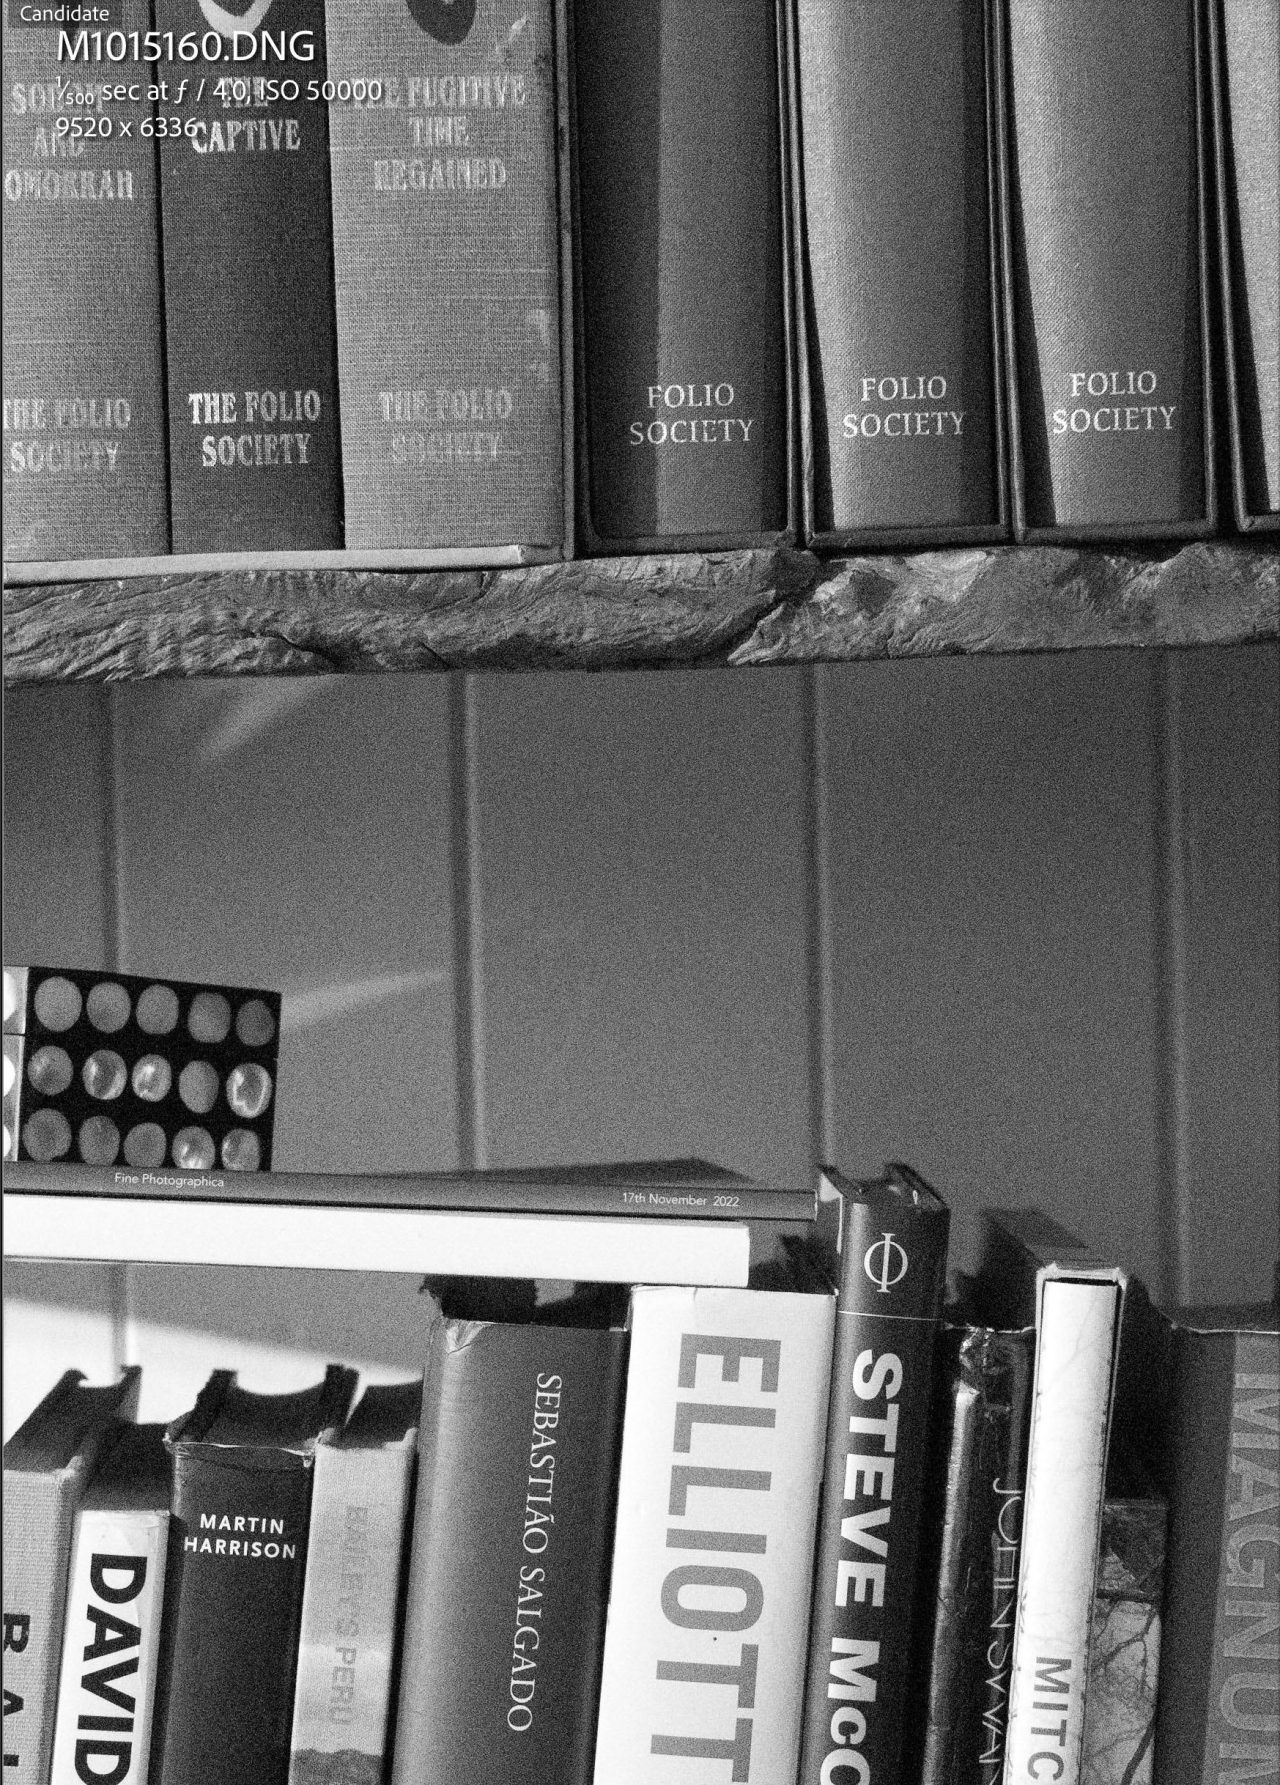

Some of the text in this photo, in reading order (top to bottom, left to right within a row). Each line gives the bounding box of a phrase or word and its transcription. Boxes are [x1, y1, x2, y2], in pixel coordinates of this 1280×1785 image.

[407, 74, 526, 108] FUGITIVE
[191, 119, 301, 153] CAPTIVE
[409, 115, 470, 148] TIME
[374, 158, 507, 191] REGAINED
[646, 383, 735, 408] FOLIO
[860, 376, 947, 401] FOLIO
[1069, 370, 1158, 397] FOLIO
[188, 390, 321, 425] THE FOLIO
[434, 389, 514, 420] FOLIO
[1052, 406, 1176, 434] SOCIETY
[629, 420, 754, 445] SOCIETY
[841, 412, 966, 438] SOCIETY
[201, 434, 312, 467] SOCIETY
[115, 1172, 225, 1188] Fine Photographica
[622, 1192, 740, 1208] 17th November 2022
[835, 1349, 904, 1608] STEVE
[200, 1513, 284, 1535] MARTIN
[184, 1536, 296, 1560] HARRISON
[507, 1372, 562, 1732] SEBASTIÃO SALGADO
[650, 1333, 782, 1783] ELLIOTT
[74, 1553, 148, 1785] DAVID
[330, 1646, 357, 1726] PERU
[1027, 1656, 1072, 1781] MITC
